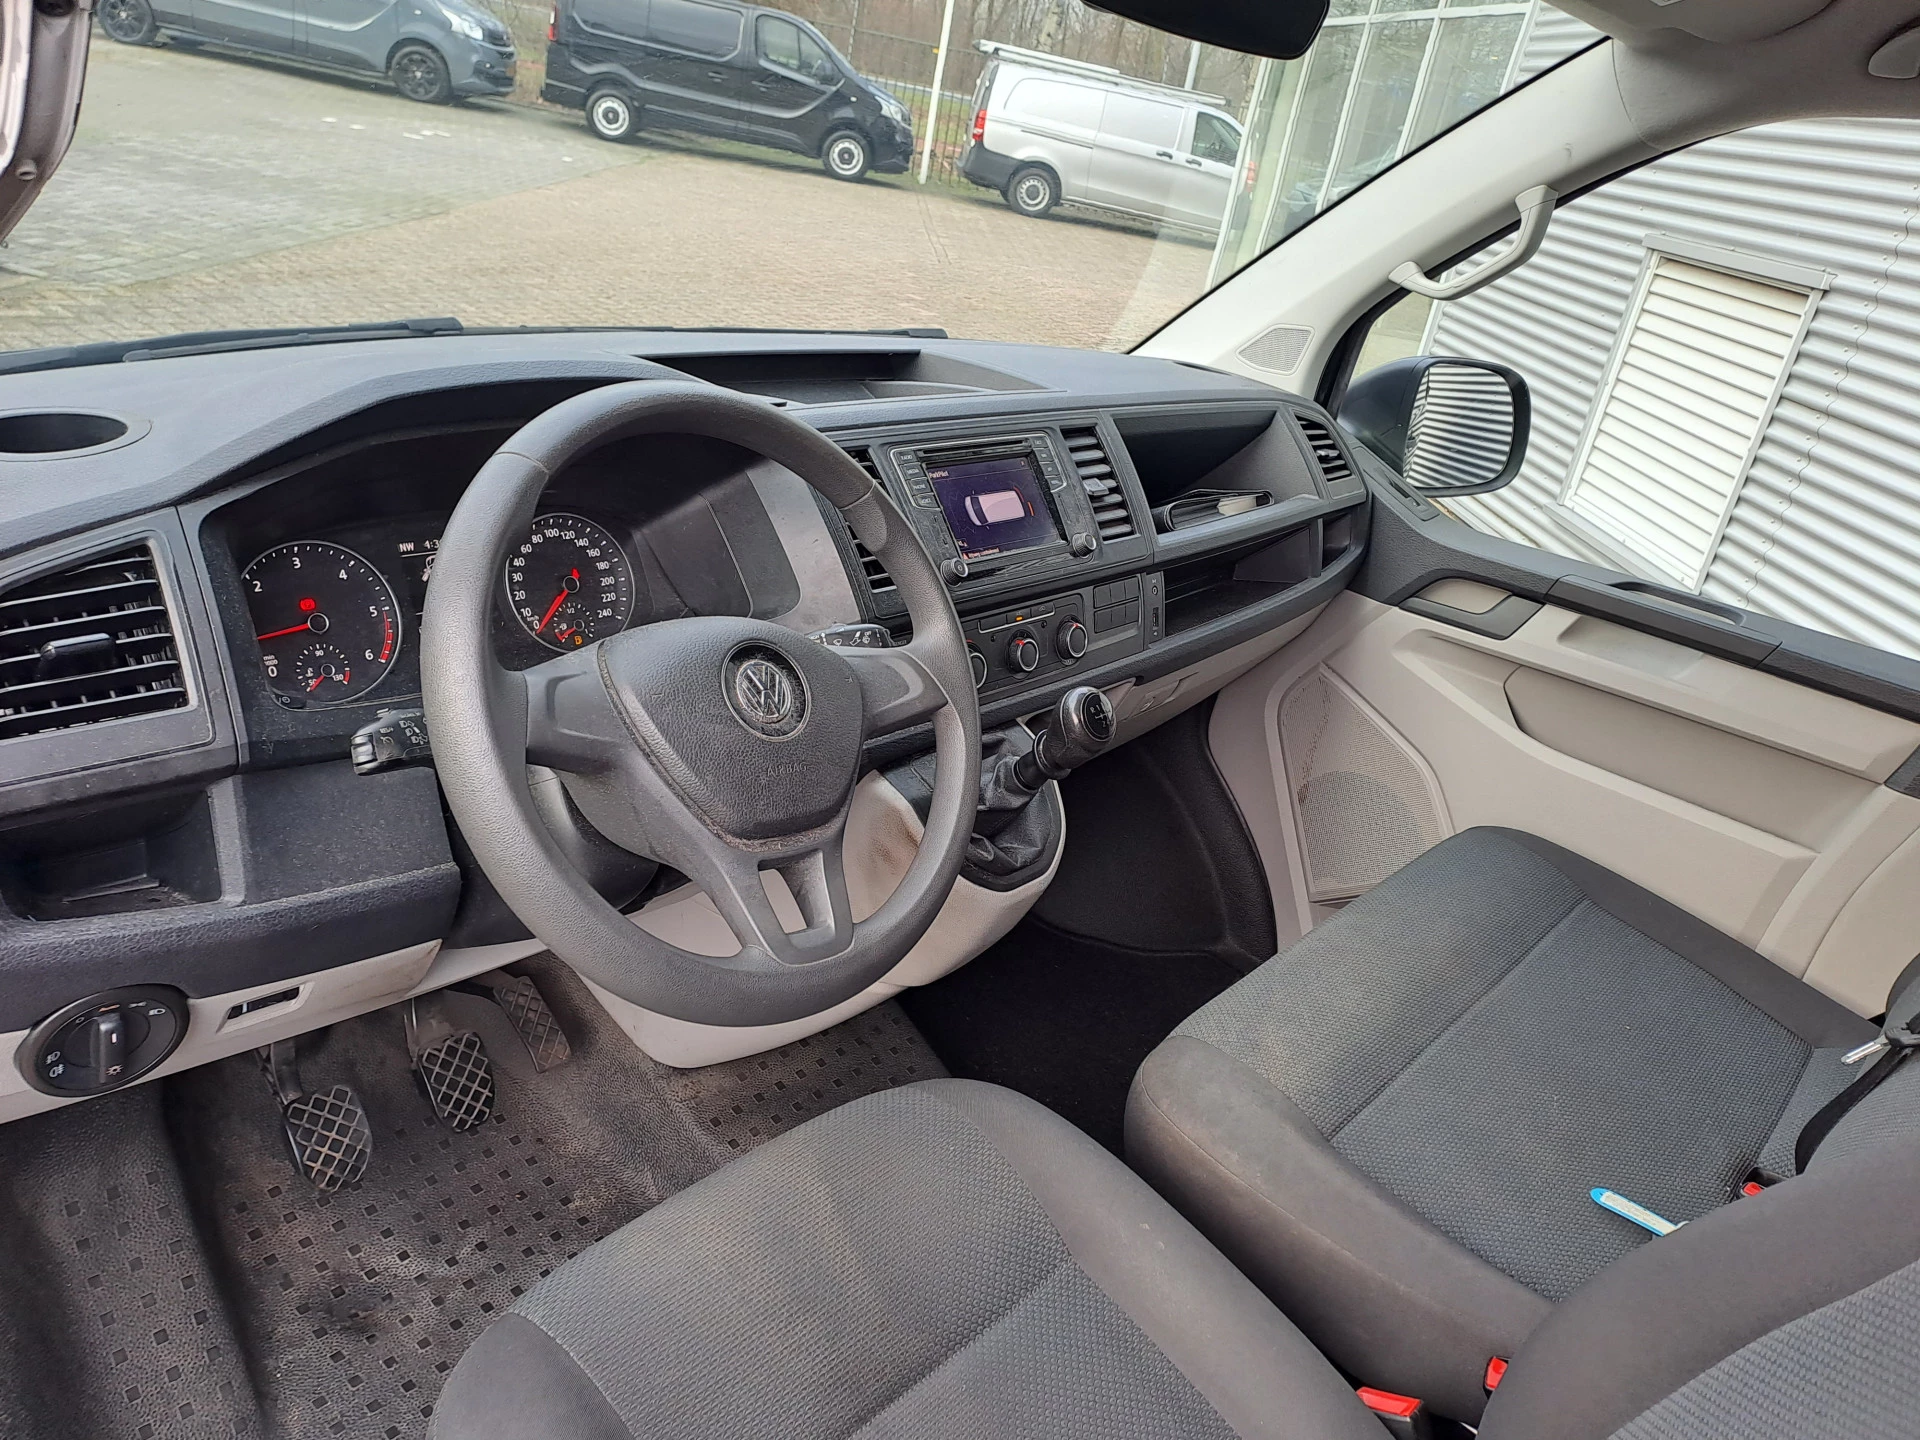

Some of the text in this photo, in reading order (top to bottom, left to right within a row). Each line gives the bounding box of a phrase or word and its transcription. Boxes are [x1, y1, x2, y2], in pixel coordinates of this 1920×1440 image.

[544, 528, 559, 538] 100
[561, 530, 576, 540] 120
[531, 534, 543, 544] 80
[574, 538, 589, 547] 140
[399, 539, 440, 552] NW 4:3
[520, 544, 532, 554] 60
[586, 548, 600, 558] 160
[292, 557, 301, 569] 3
[513, 557, 525, 567] 40
[596, 561, 610, 570] 180
[339, 569, 348, 580] 4
[512, 572, 523, 582] 30
[252, 580, 263, 592] 2
[600, 576, 615, 586] 200
[513, 590, 526, 600] 20
[601, 592, 616, 602] 220
[369, 605, 378, 617] 5
[520, 607, 532, 617] 10
[597, 608, 612, 618] 240
[533, 620, 540, 629] 0
[364, 649, 374, 660] 6
[268, 665, 277, 677] 0
[767, 762, 808, 777] AIRBAG
